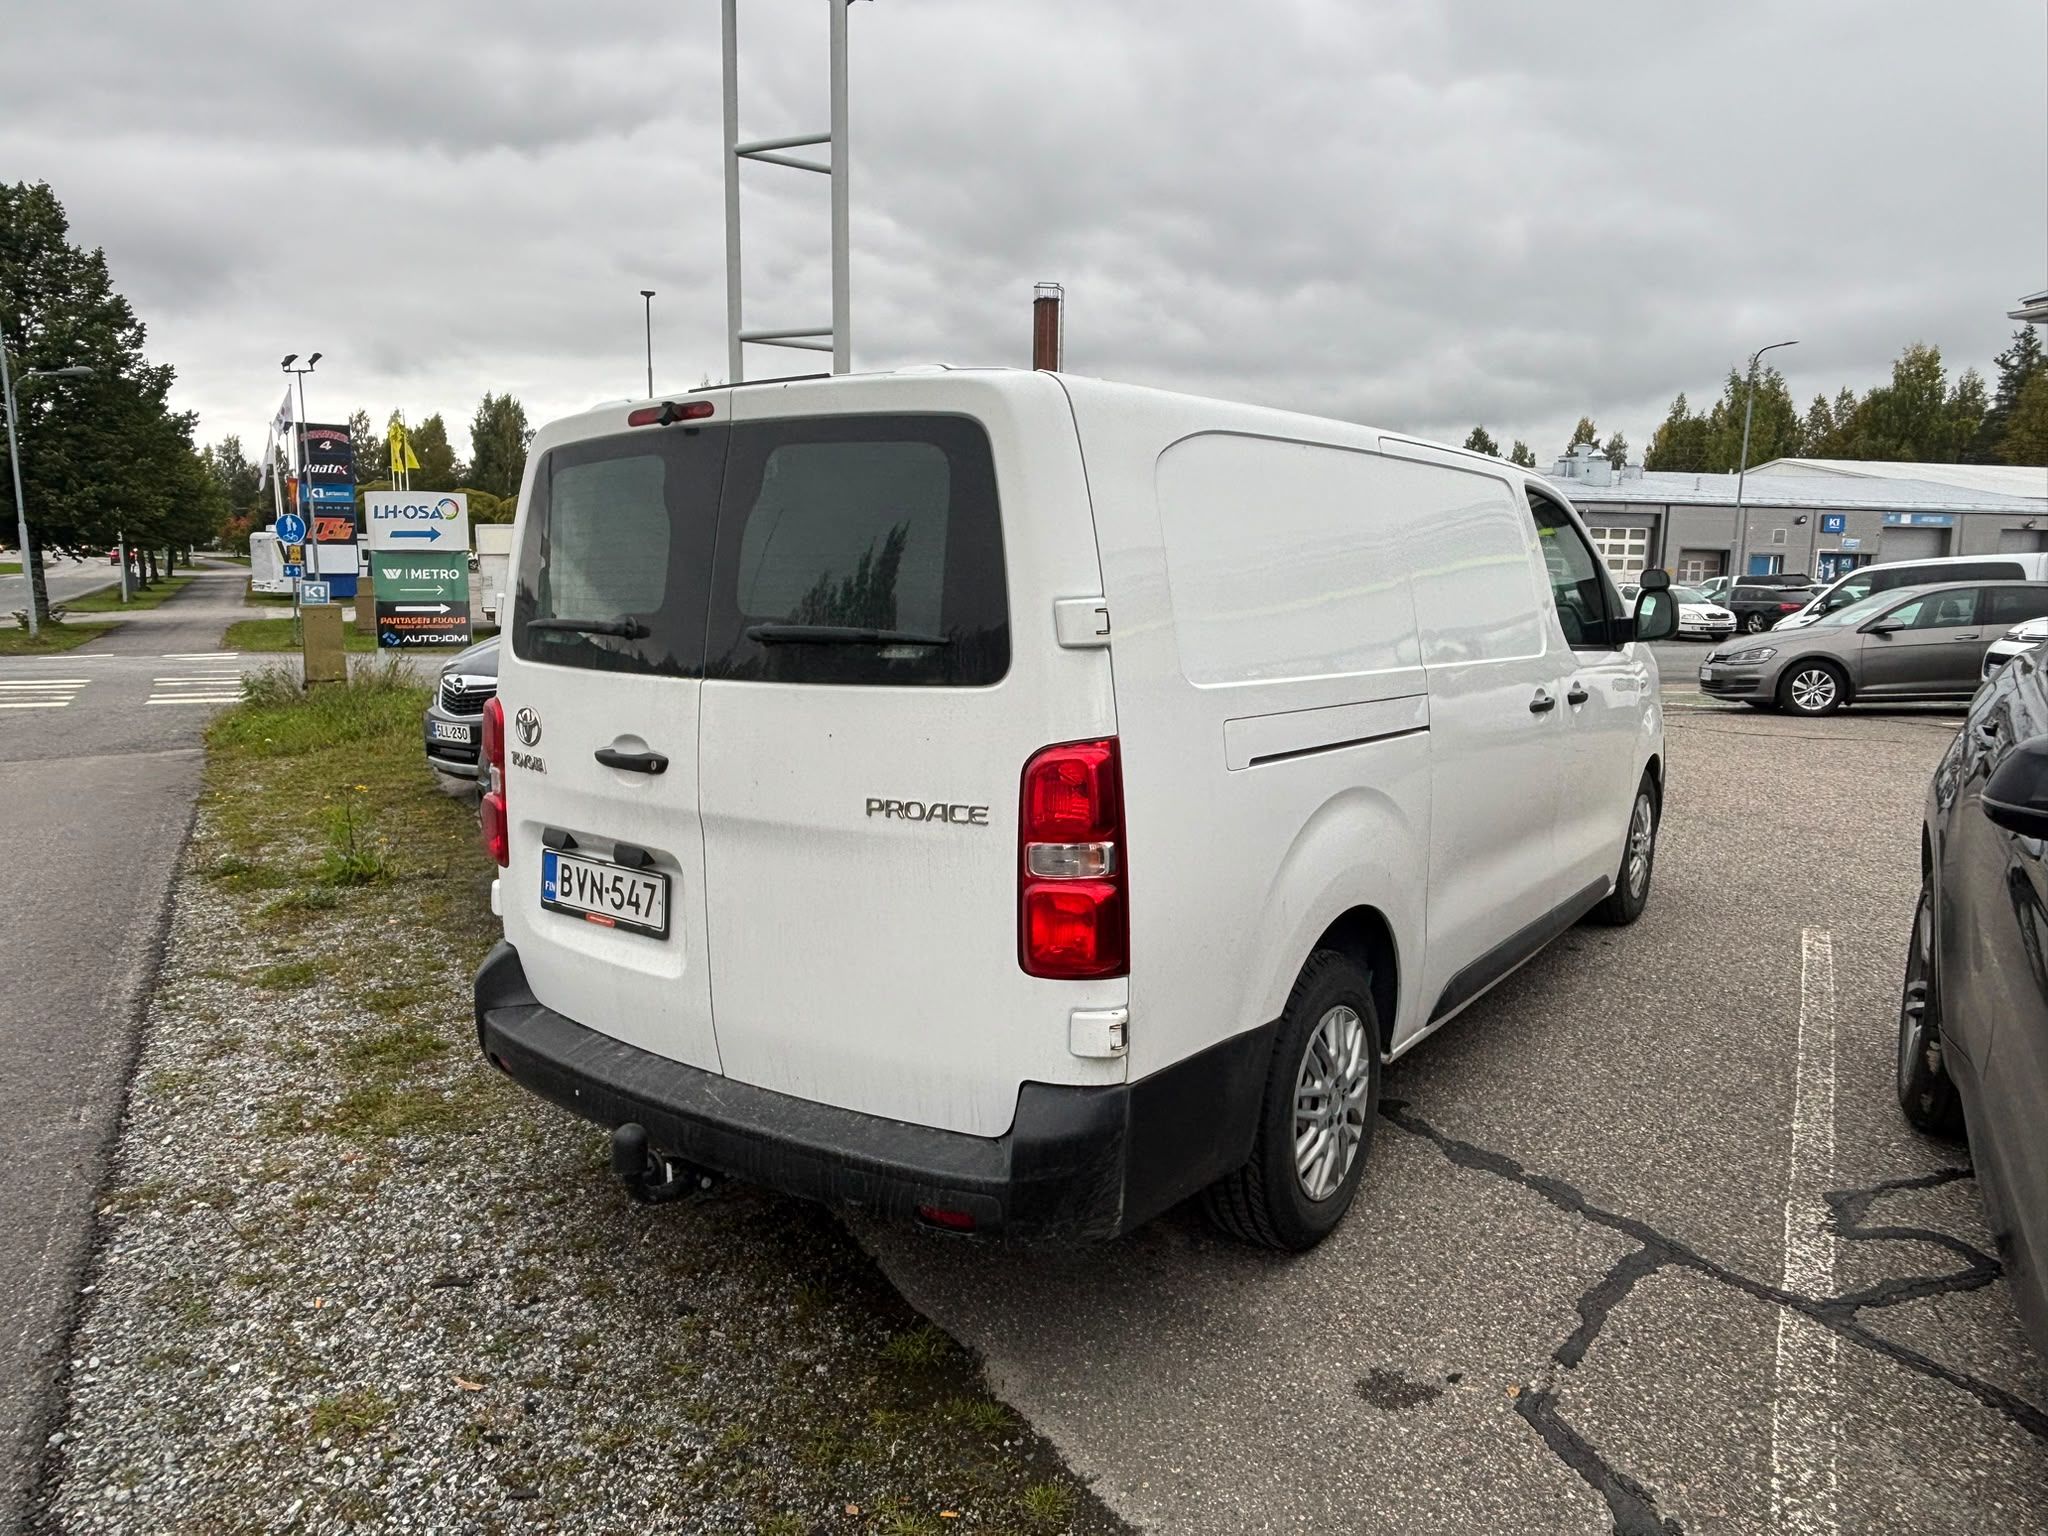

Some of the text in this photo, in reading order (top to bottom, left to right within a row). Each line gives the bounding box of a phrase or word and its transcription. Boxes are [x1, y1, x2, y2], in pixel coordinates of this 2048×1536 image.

[320, 440, 332, 450] 4
[373, 504, 444, 520] LH-OSA
[410, 568, 460, 580] METRO
[402, 634, 468, 643] AUTO-JOMI
[866, 798, 989, 826] PROACE
[545, 880, 556, 892] FIN
[560, 863, 657, 918] BVN-547
